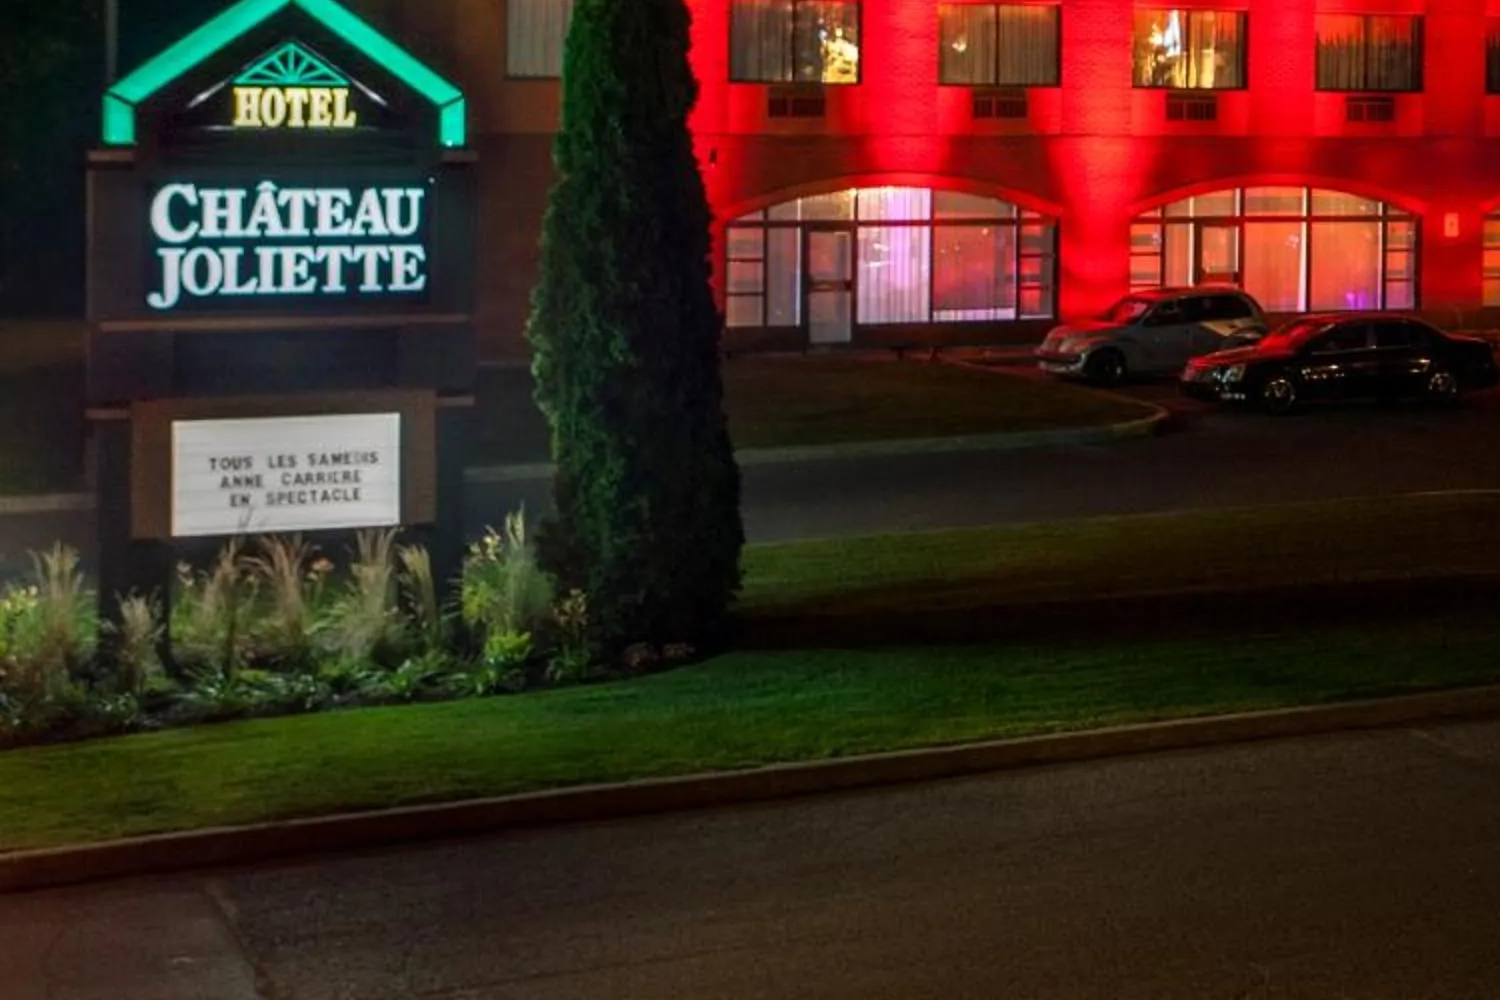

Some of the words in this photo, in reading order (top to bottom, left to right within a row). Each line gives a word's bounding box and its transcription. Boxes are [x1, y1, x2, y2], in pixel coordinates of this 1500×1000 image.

[232, 86, 357, 128] HOTEL
[149, 180, 425, 243] CHÂTEAU
[146, 245, 427, 310] JOLIETTE
[209, 456, 253, 471] TOUS
[268, 454, 297, 469] LES
[220, 474, 264, 488] ANNE
[229, 493, 251, 507] EN
[265, 487, 361, 506] SPECTACLE
